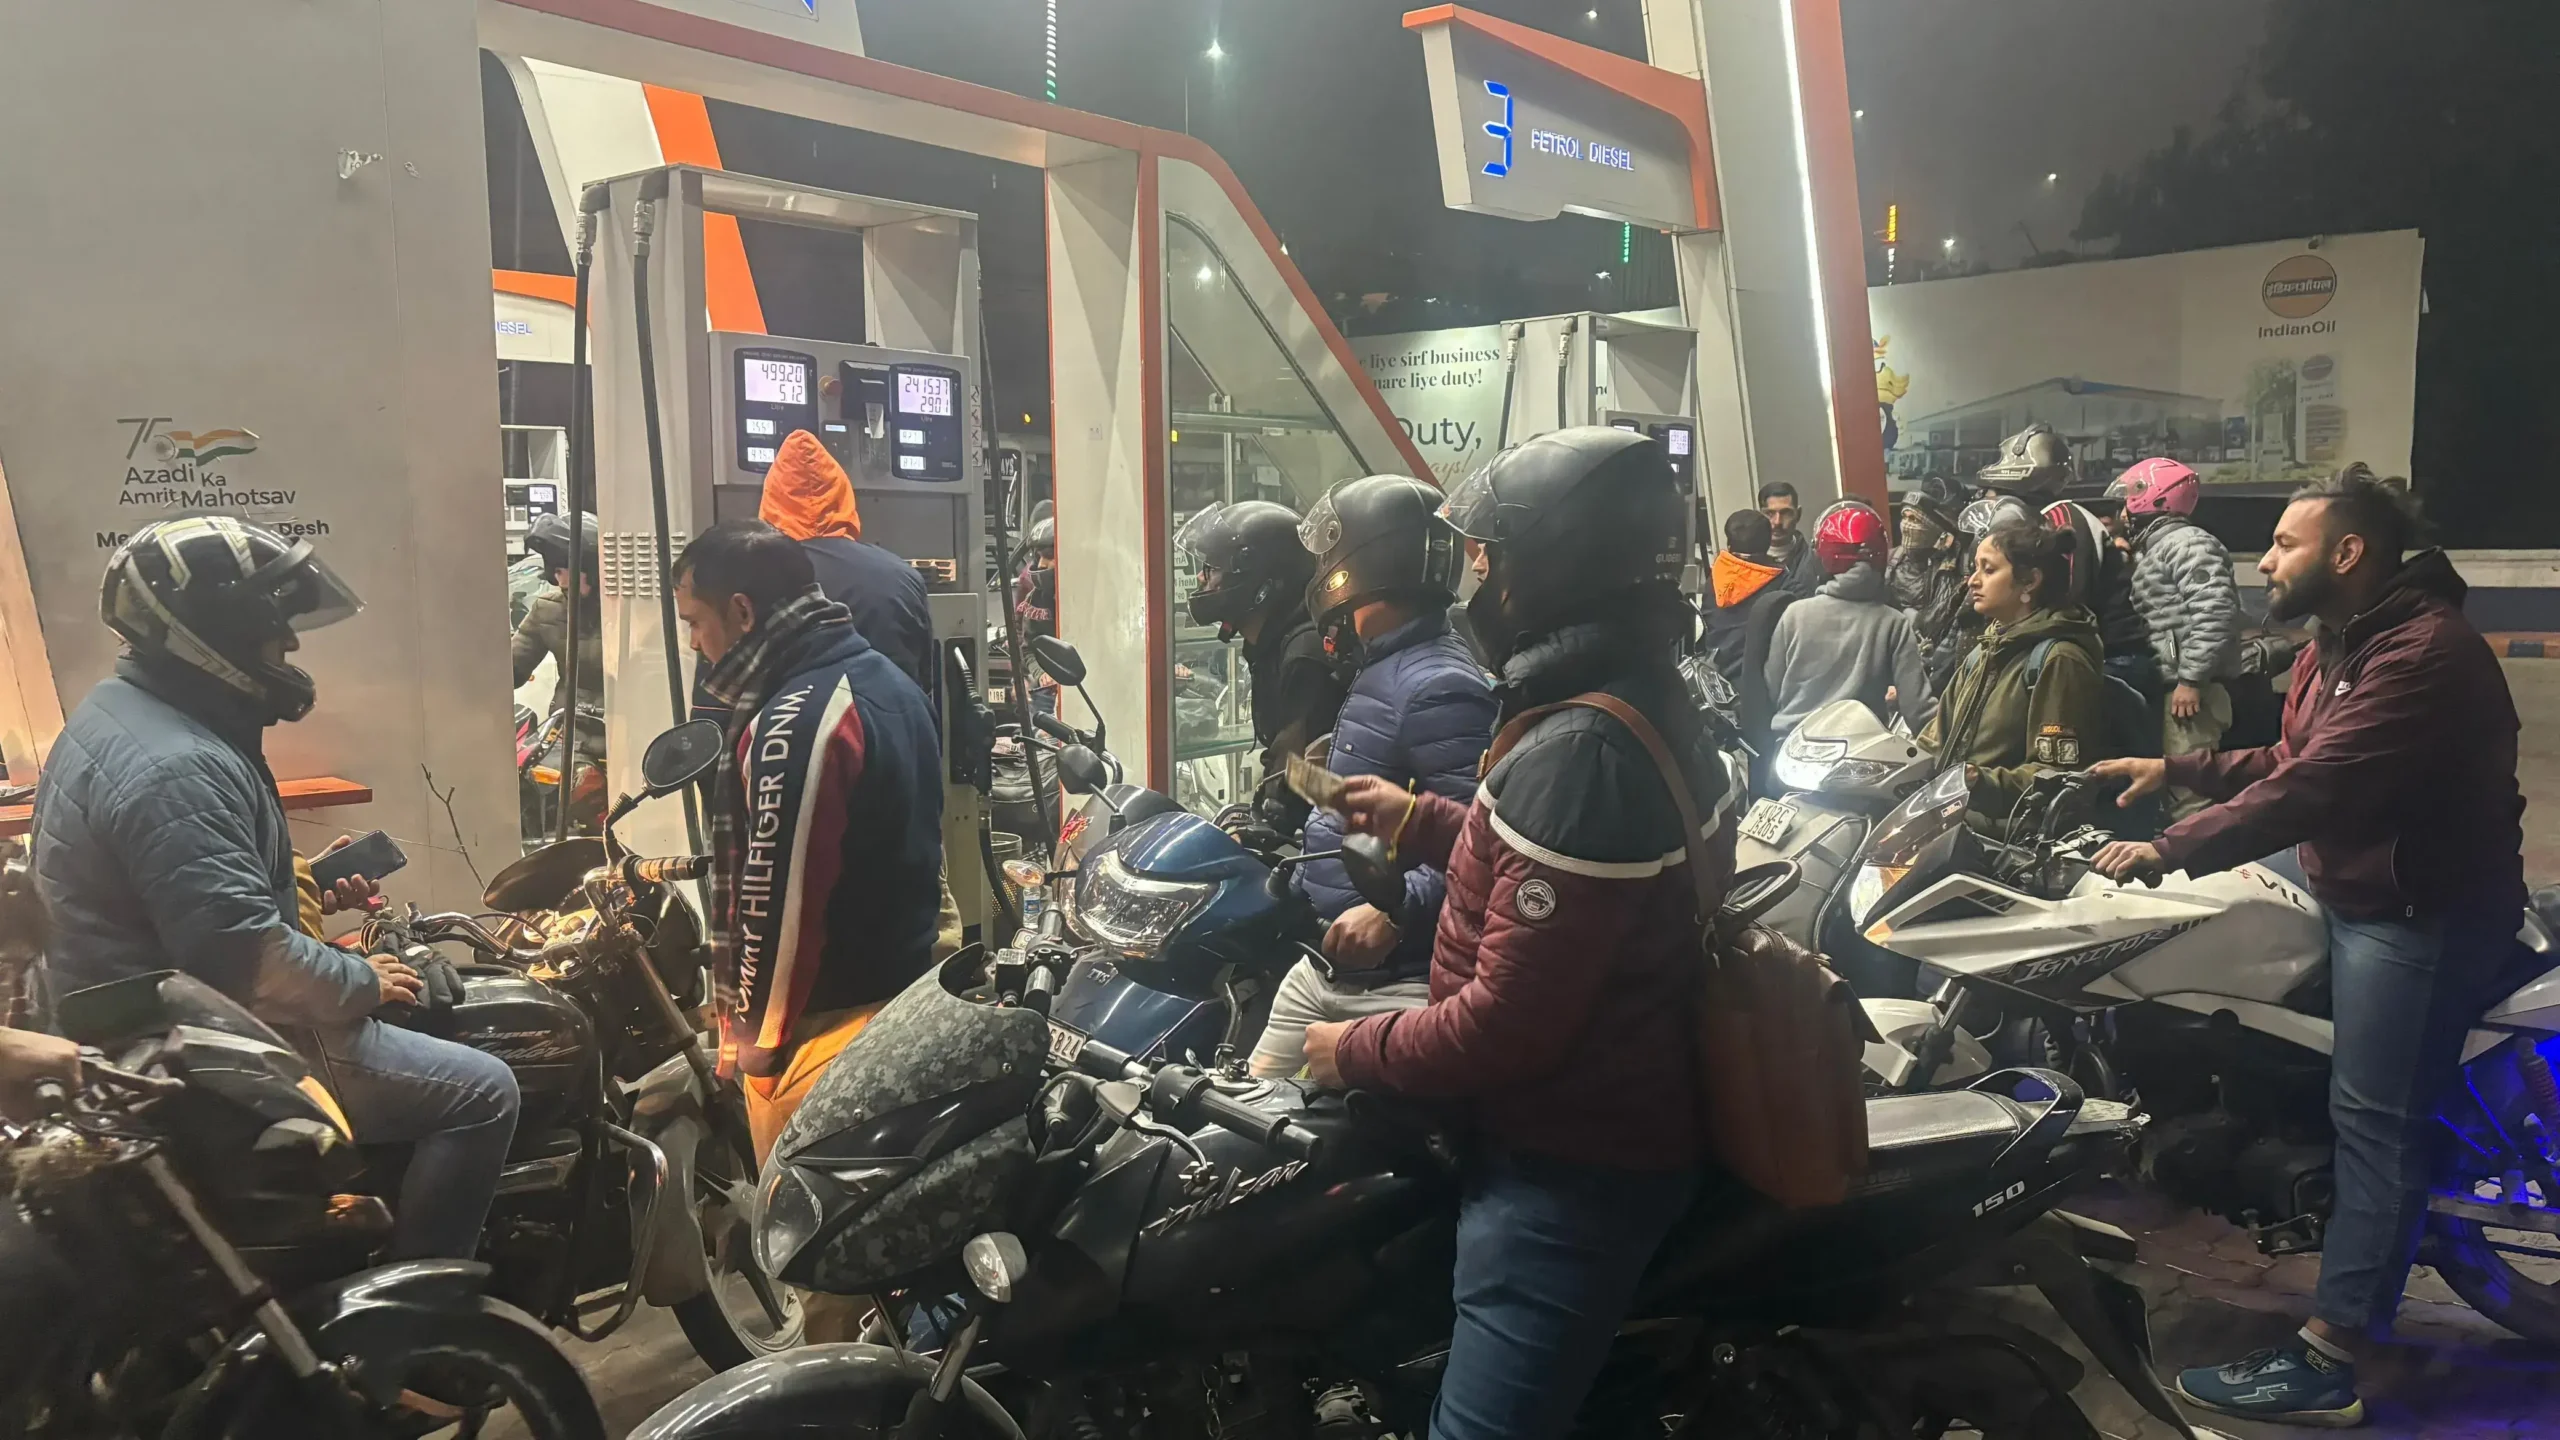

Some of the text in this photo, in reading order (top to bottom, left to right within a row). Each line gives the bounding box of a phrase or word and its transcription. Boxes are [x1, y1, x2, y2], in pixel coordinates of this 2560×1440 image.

[1481, 79, 1514, 178] 3
[1531, 128, 1635, 172] PETROL DIESEL
[2258, 320, 2337, 339] IndianOil
[1400, 349, 1428, 367] sirf
[1430, 347, 1500, 365] business
[1410, 372, 1438, 390] liye
[1441, 368, 1482, 387] duty!
[124, 463, 227, 487] Azadi Ka
[118, 487, 297, 509] Amrit Mahotsav
[278, 519, 331, 537] Desh
[760, 682, 815, 764] DNM.
[741, 770, 785, 919] HILFIGER
[2014, 928, 2167, 985] IGNITOR
[1087, 967, 1111, 984] TVS
[1971, 1180, 2026, 1218] 150
